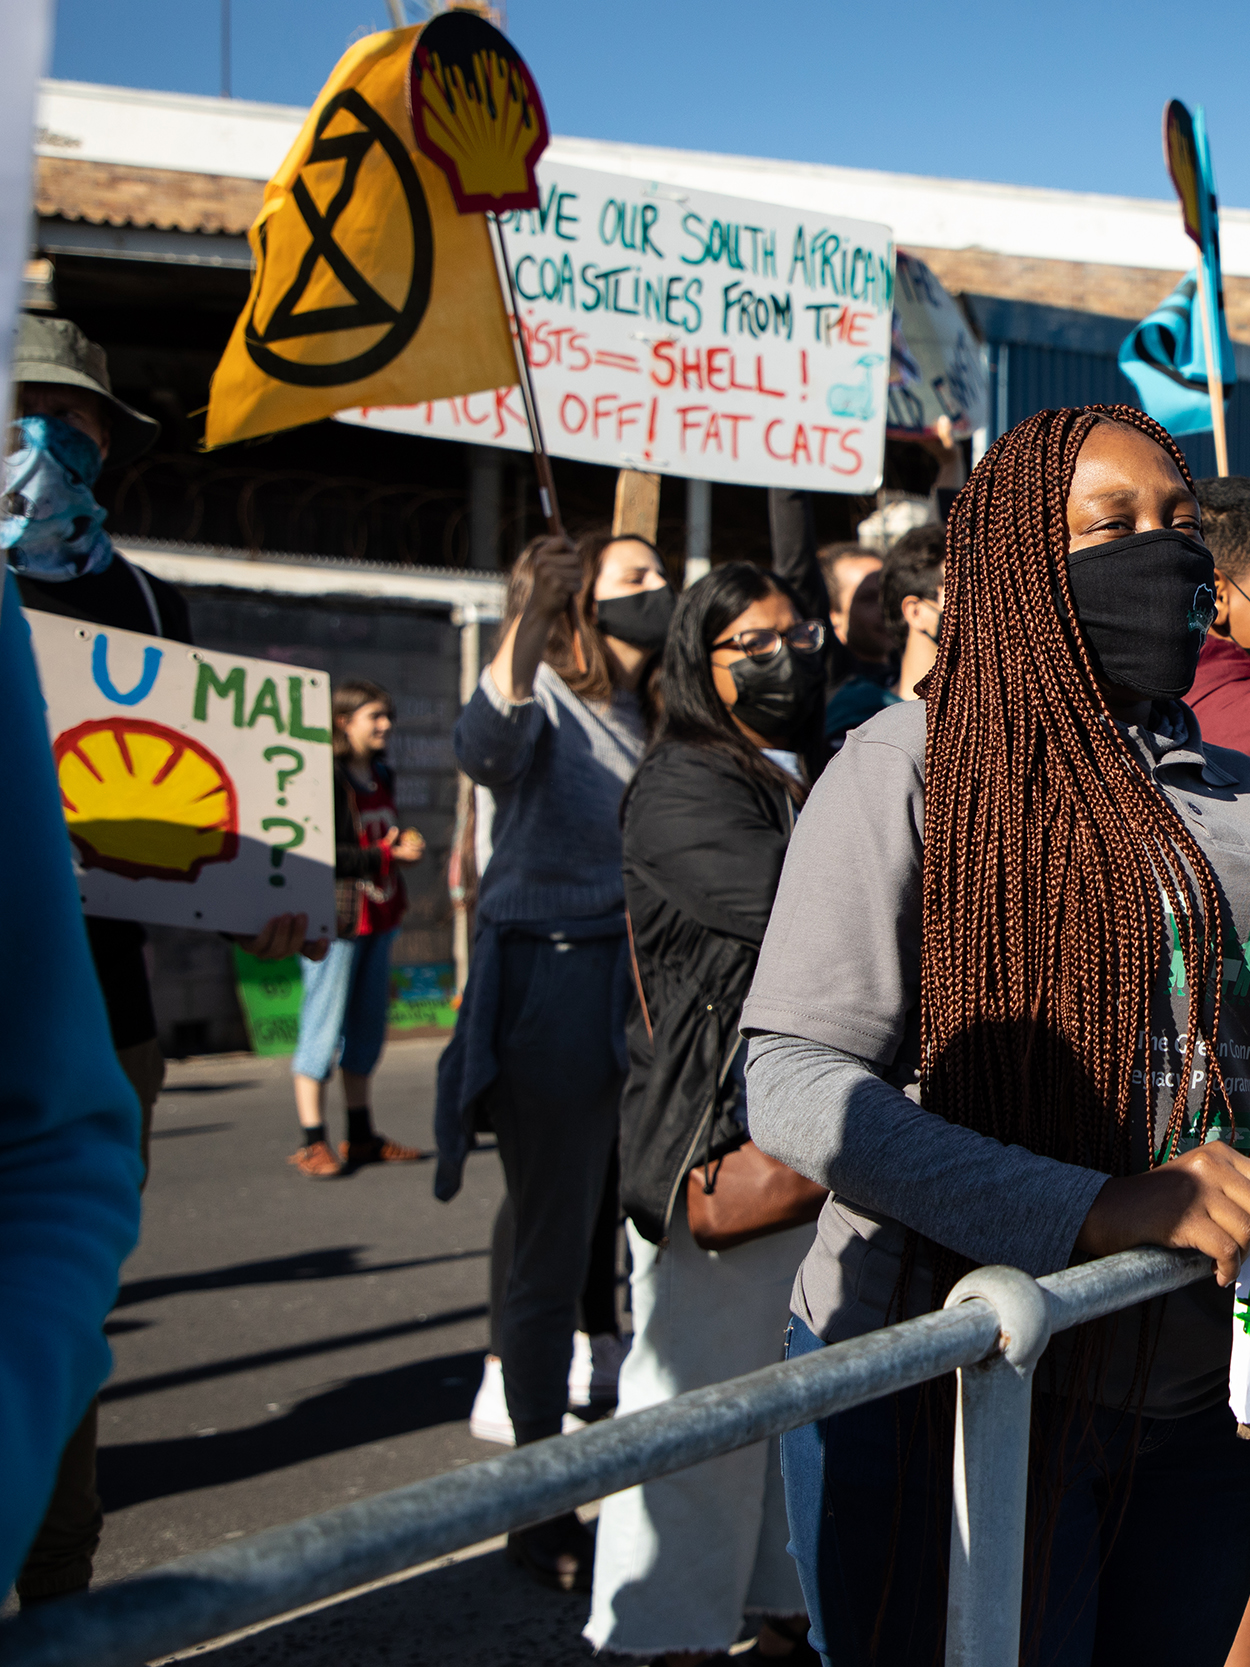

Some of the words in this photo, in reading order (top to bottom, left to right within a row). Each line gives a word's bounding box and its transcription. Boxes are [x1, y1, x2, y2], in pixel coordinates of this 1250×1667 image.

[499, 183, 579, 241] AVE
[599, 198, 665, 259] OUR
[680, 213, 778, 279] SOUTH
[722, 280, 794, 342] FROM
[805, 304, 876, 348] THE
[560, 393, 659, 462] OFF!
[676, 405, 754, 461] FAT
[764, 418, 863, 475] CATS
[91, 633, 163, 706] U
[192, 661, 332, 745] MAL
[1131, 1068, 1183, 1092] egacy
